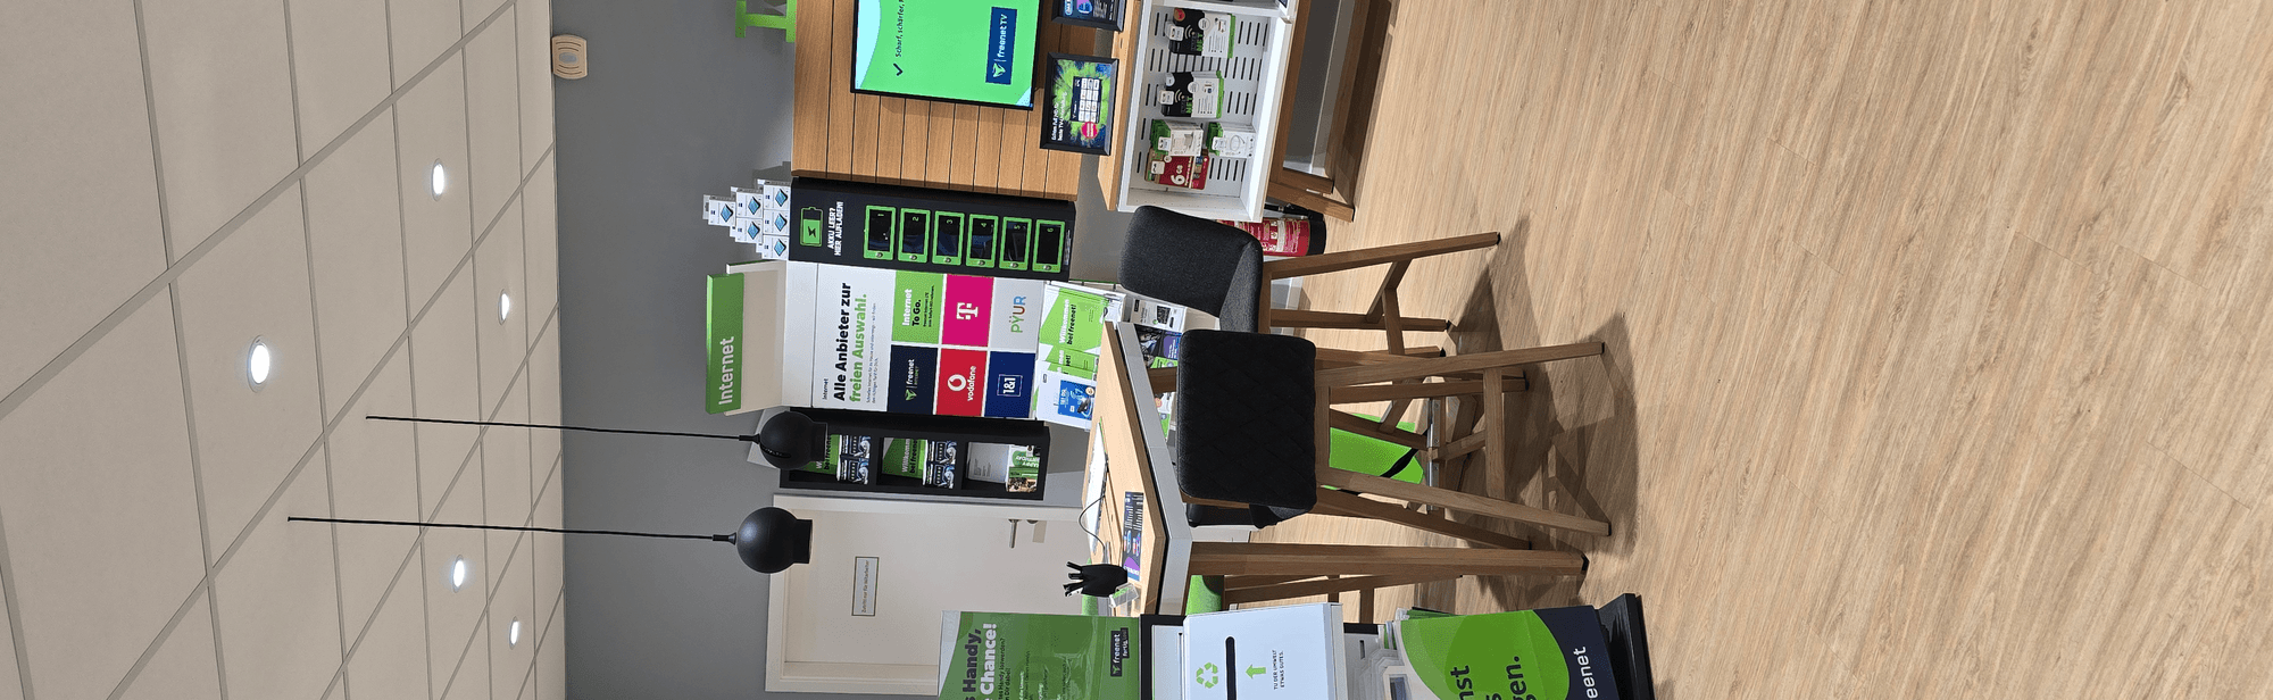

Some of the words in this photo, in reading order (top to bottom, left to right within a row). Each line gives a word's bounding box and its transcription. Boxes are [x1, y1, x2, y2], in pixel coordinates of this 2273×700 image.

[896, 4, 905, 33] schärfer,
[1000, 14, 1008, 25] TV
[895, 35, 903, 57] Scharf,
[997, 26, 1007, 58] freenet
[1170, 175, 1185, 185] 6
[828, 207, 837, 229] LEER?
[827, 230, 836, 249] AKKU
[834, 240, 843, 256] HIER
[840, 282, 851, 307] zur
[902, 289, 912, 326] Internet
[913, 300, 921, 314] Go.
[852, 294, 867, 359] Auswahl.
[912, 316, 920, 326] To
[1009, 296, 1026, 333] PŸUR
[1058, 299, 1070, 343] Willkommen
[1068, 304, 1077, 332] freenet!
[835, 309, 850, 372] Anbieter
[718, 336, 734, 404] Internet
[849, 362, 863, 402] freien
[906, 359, 915, 385] freenet
[967, 366, 977, 401] vodafone
[834, 374, 846, 401] Alle
[1003, 377, 1016, 394] 1&1
[962, 628, 982, 692] Handy,
[980, 623, 997, 694] Chance!
[1573, 646, 1599, 700] eenet
